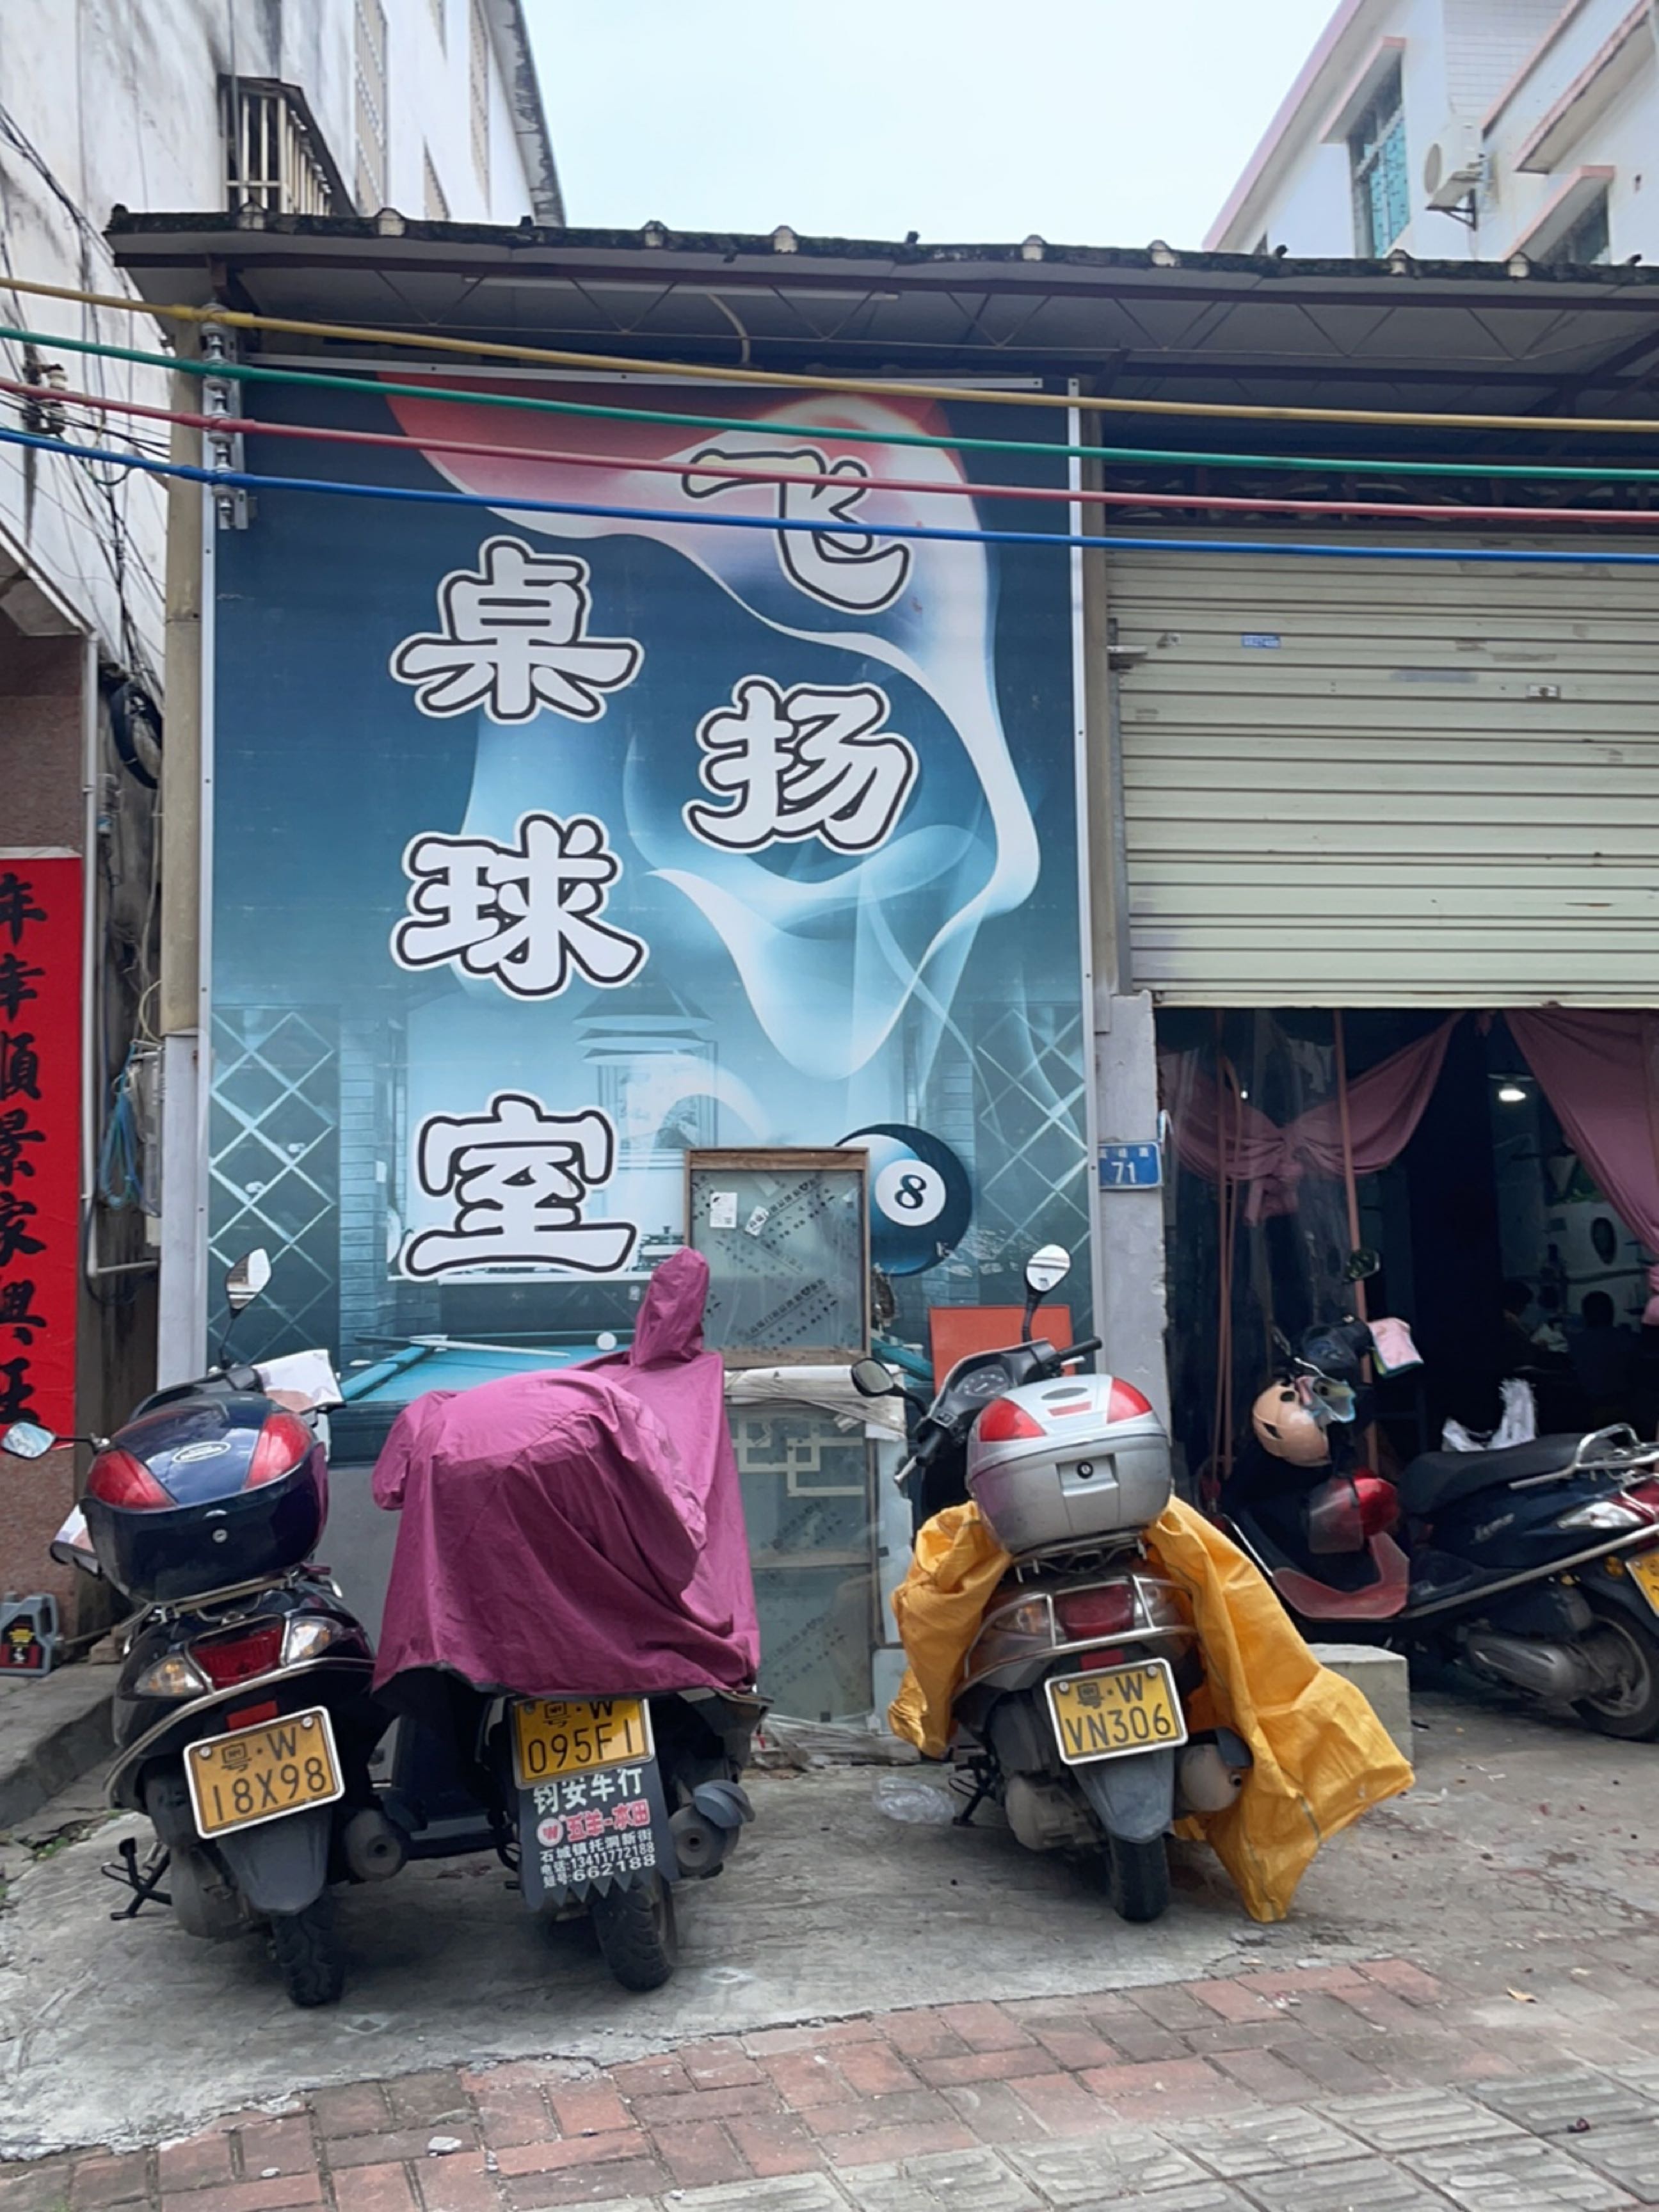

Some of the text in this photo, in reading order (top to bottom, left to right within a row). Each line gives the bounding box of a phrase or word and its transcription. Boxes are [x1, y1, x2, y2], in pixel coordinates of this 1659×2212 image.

[680, 444, 917, 854] 飞扬
[389, 534, 649, 1281] 桌球室
[894, 1173, 927, 1209] 8
[1111, 1161, 1137, 1184] 71
[528, 1719, 634, 1774] 095F1
[1065, 1703, 1171, 1752] VN306
[212, 1756, 327, 1822] 18X98
